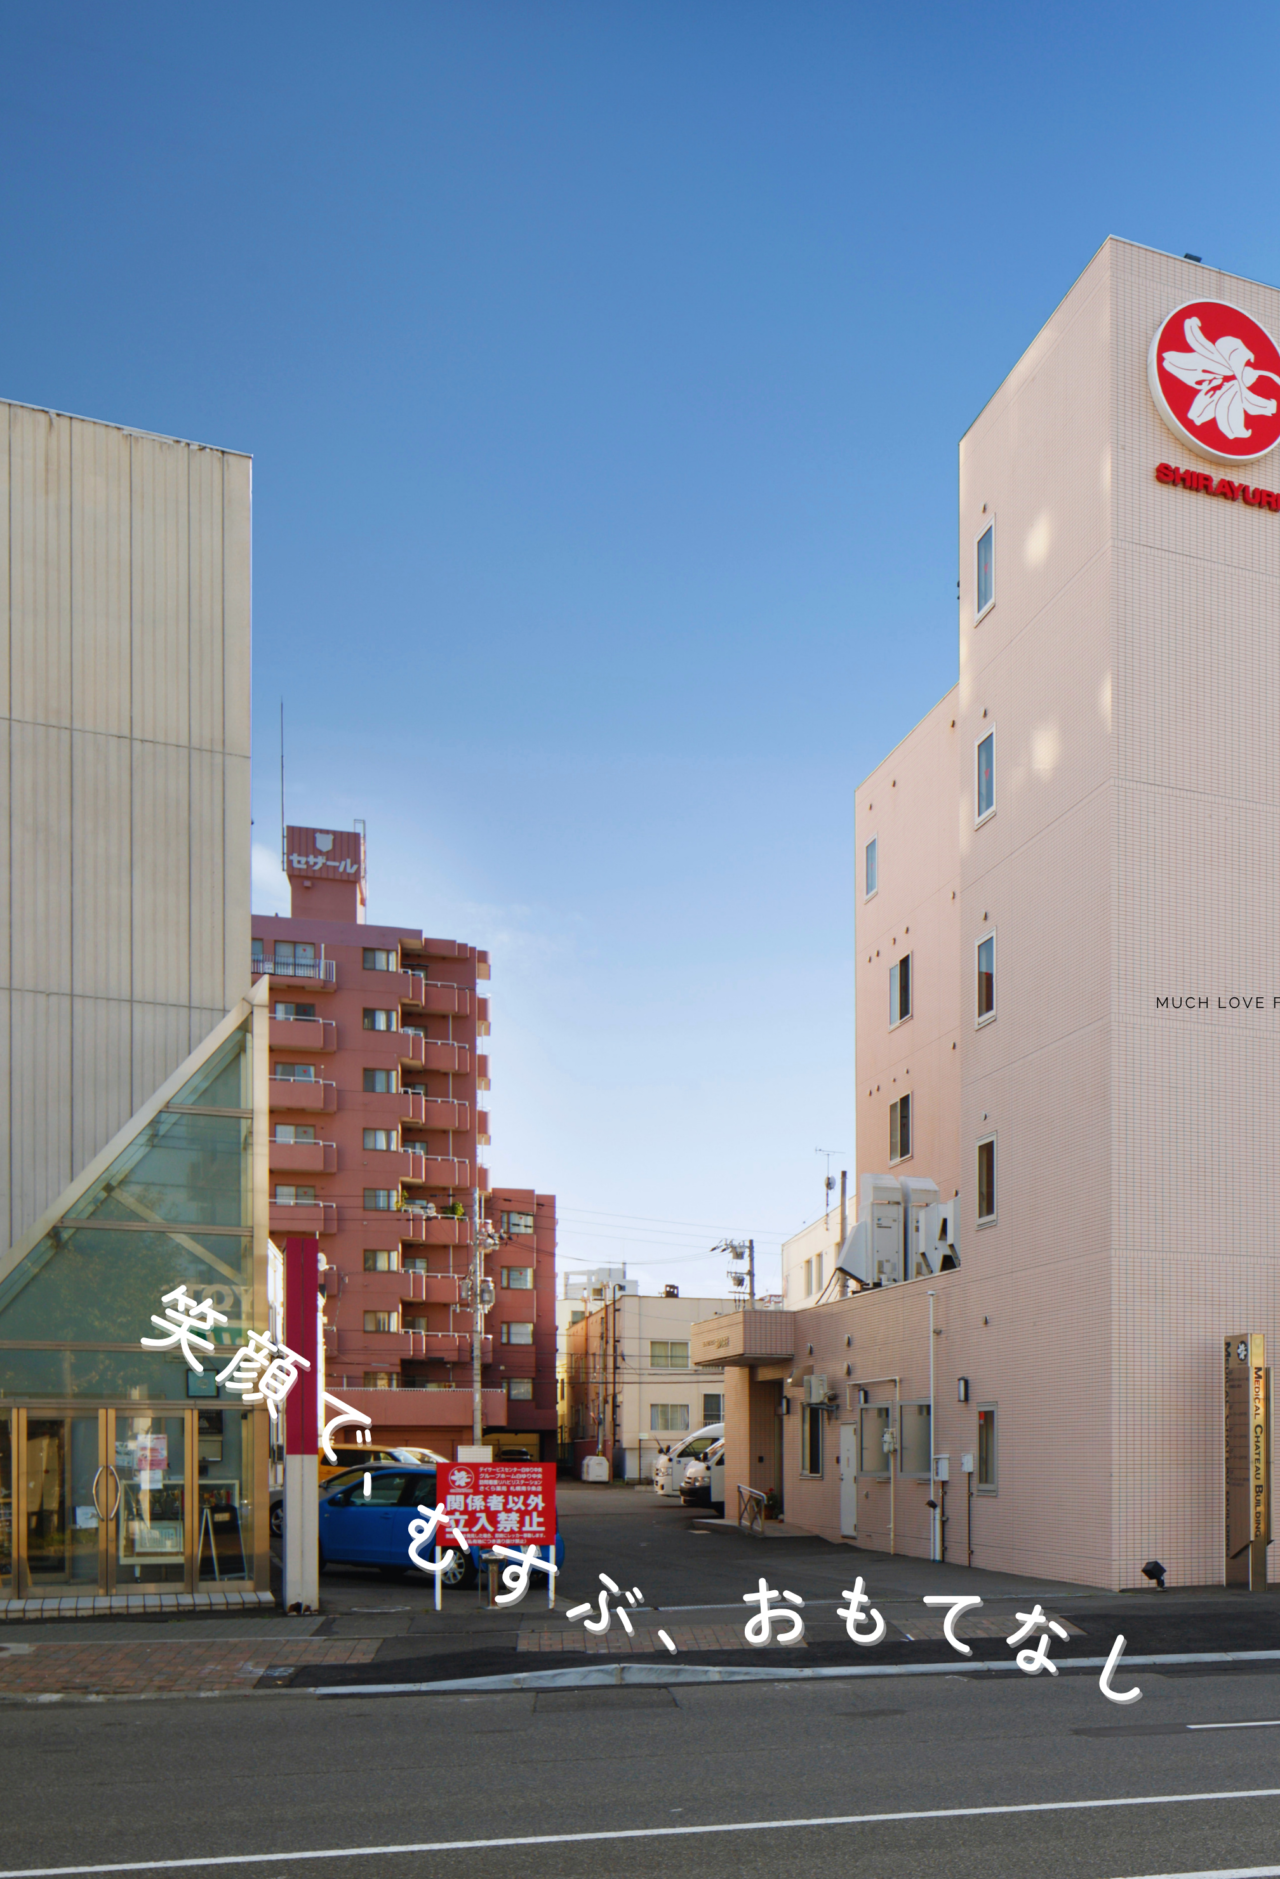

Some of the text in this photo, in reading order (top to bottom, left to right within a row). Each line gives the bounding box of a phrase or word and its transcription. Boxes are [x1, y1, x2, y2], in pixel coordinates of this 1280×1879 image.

[288, 853, 359, 874] セザール
[1253, 1366, 1264, 1538] MEDICAL CHATEAU BUILDING
[446, 1494, 546, 1511] 関係者以外
[445, 1512, 546, 1532] 立入禁止
